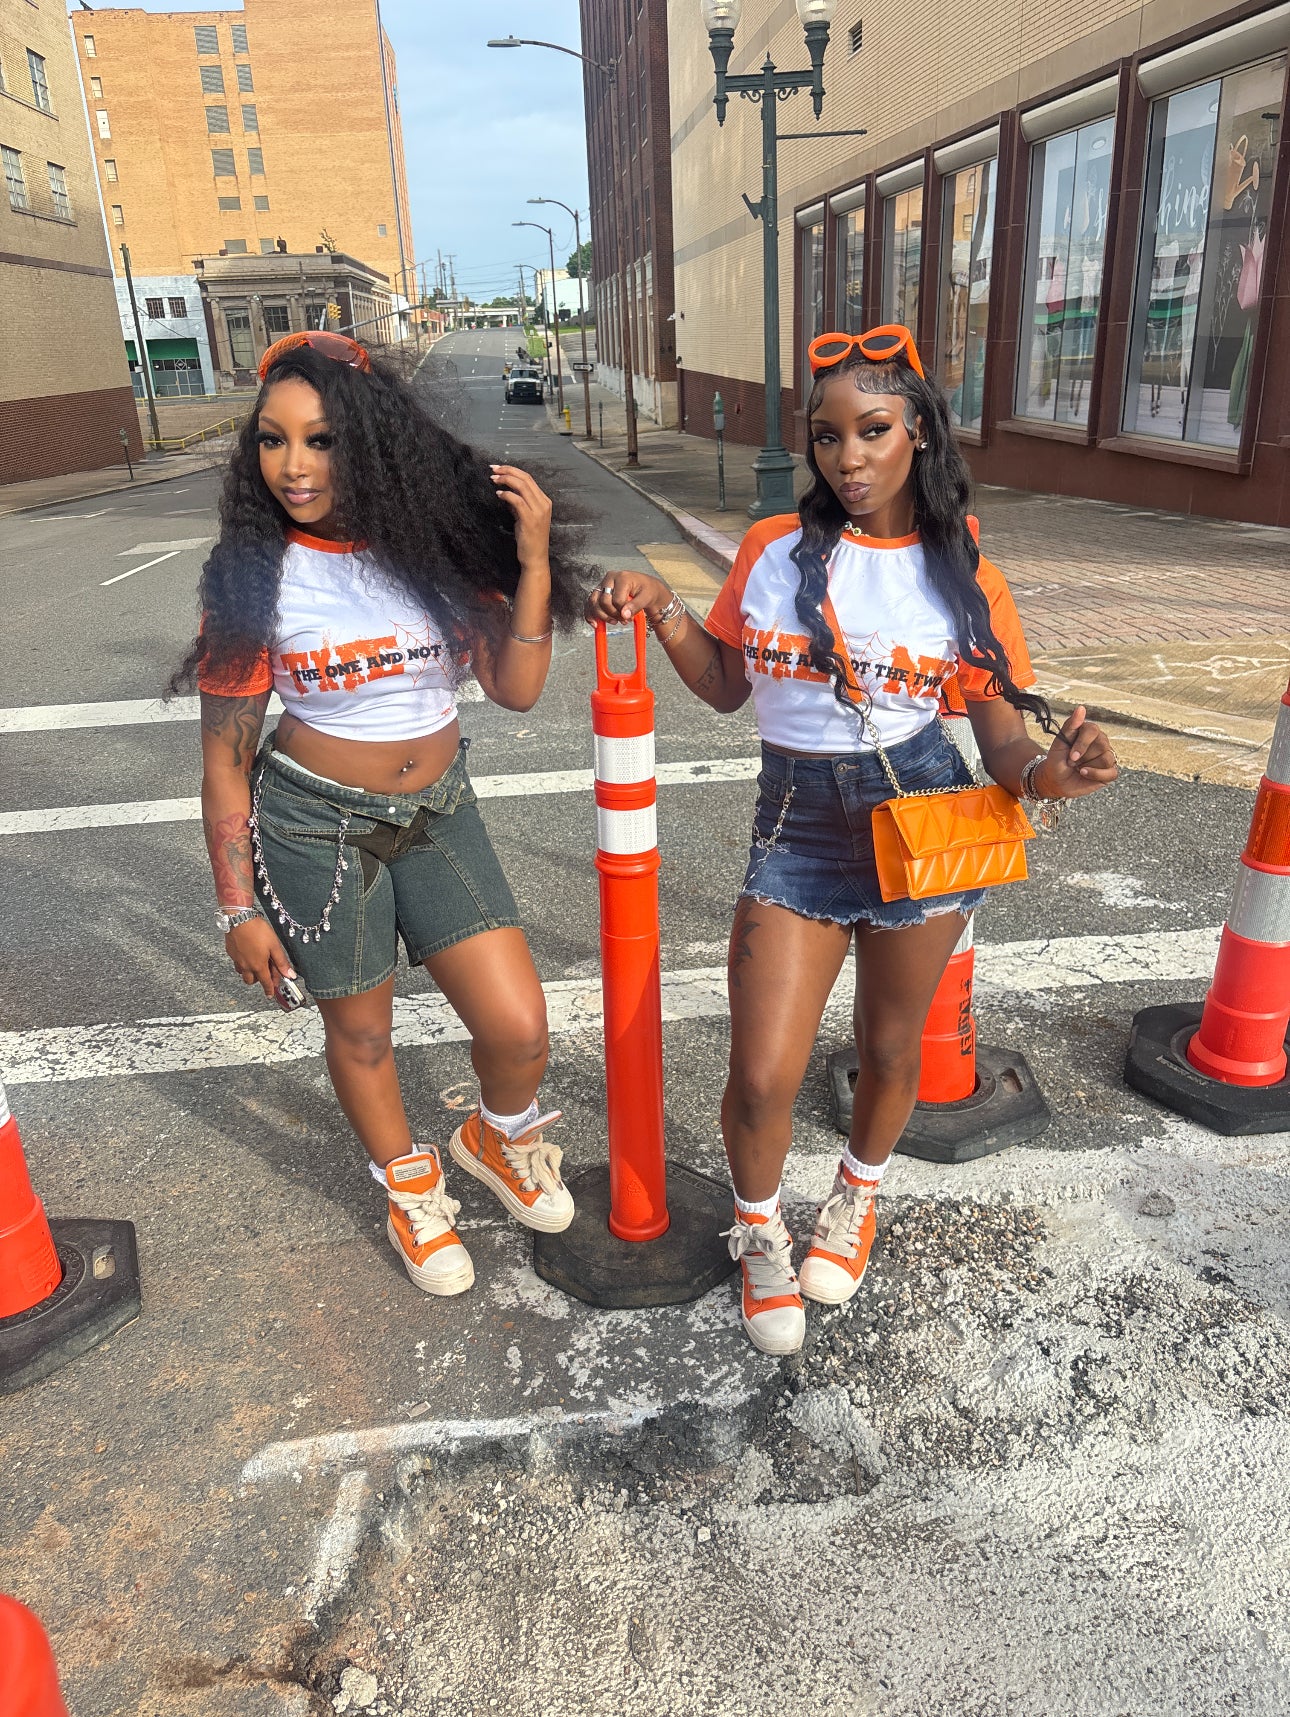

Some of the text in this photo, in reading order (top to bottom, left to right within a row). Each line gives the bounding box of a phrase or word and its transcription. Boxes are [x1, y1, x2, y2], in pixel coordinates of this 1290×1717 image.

[292, 667, 323, 682] THE
[324, 660, 363, 679] ONE
[366, 651, 404, 669] AND
[407, 643, 442, 661] NOT
[761, 648, 793, 665] ONE
[874, 664, 910, 682] THE
